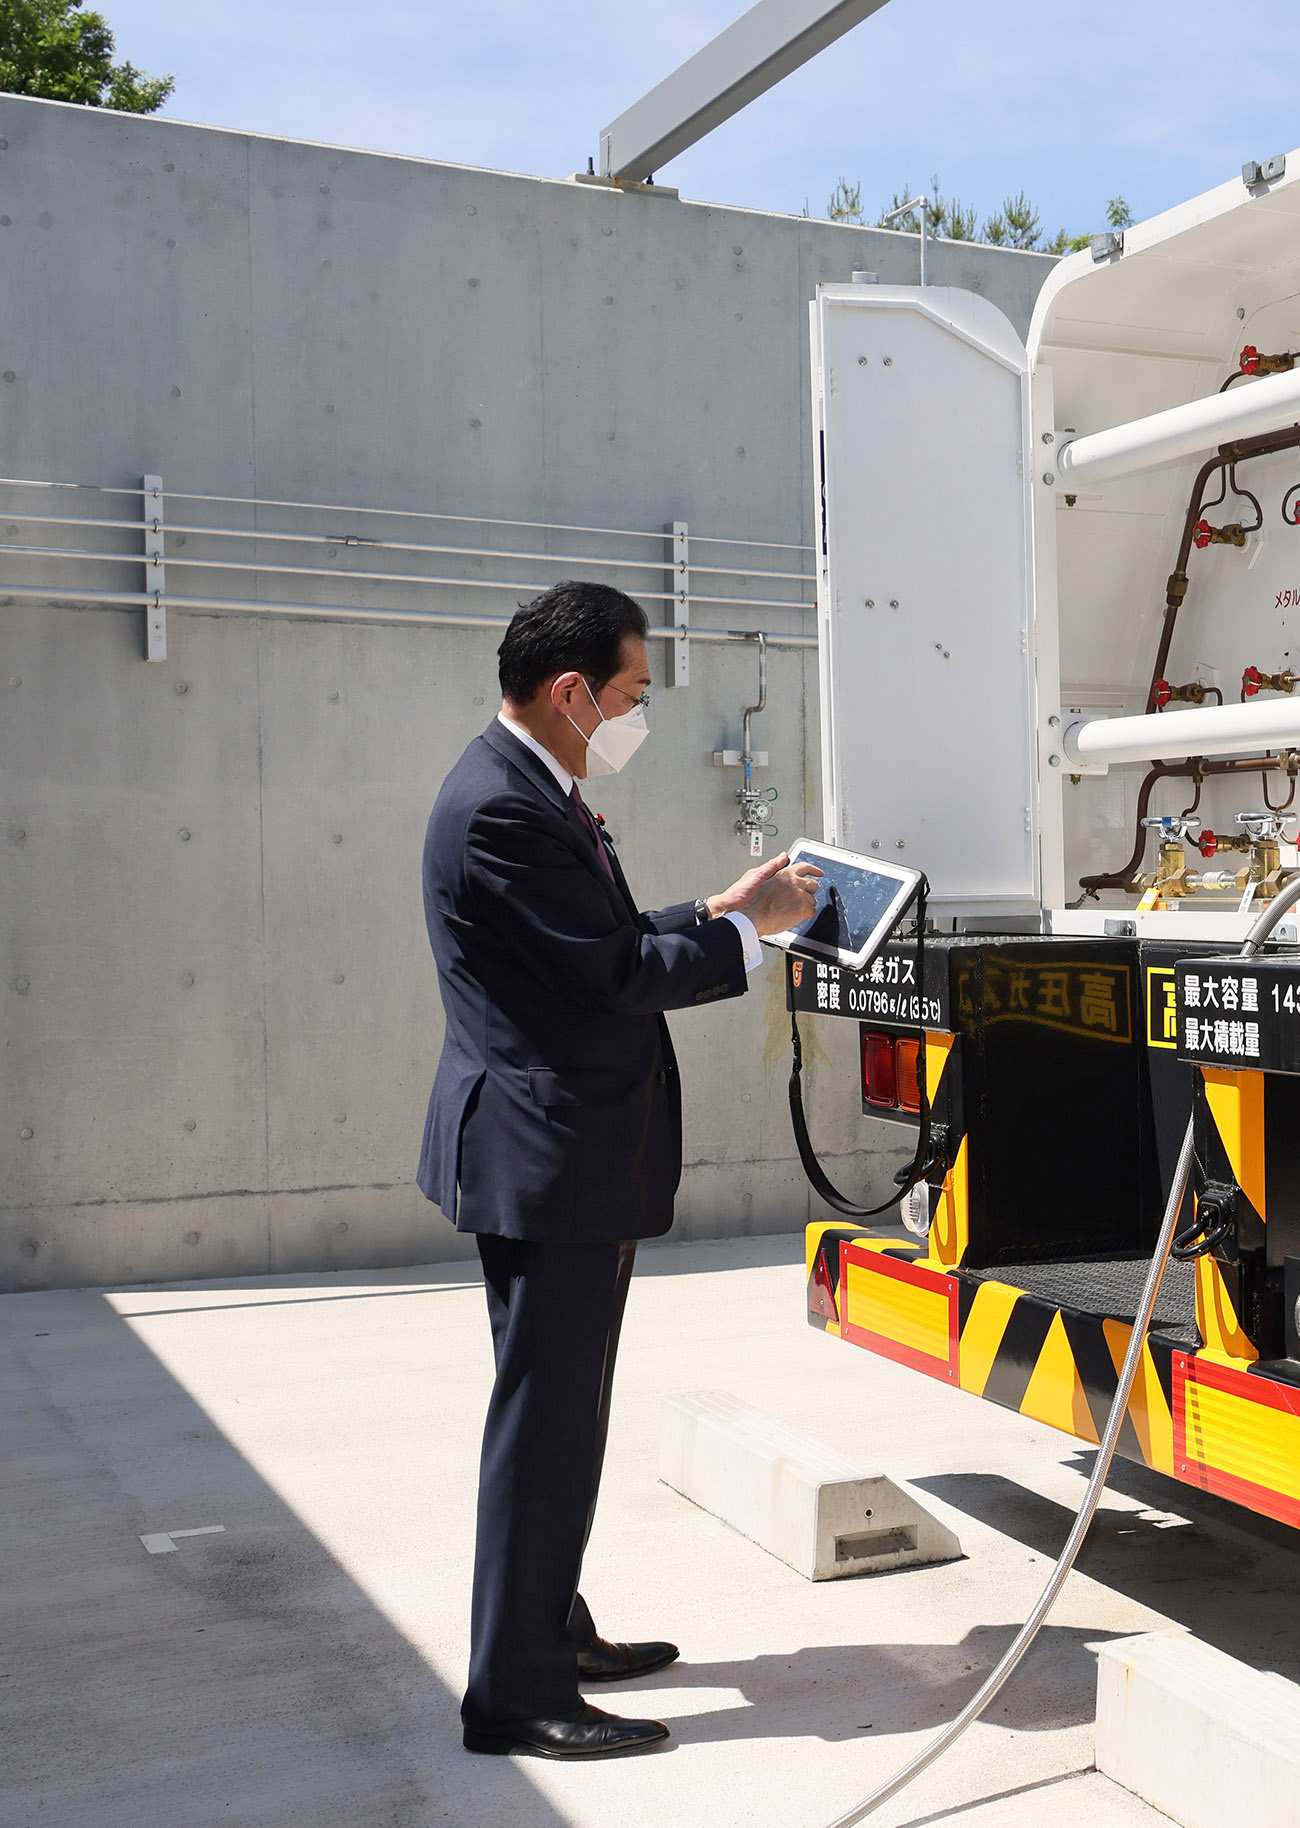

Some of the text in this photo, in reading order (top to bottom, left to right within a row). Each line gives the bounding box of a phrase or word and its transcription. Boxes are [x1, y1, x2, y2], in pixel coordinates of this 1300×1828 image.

[817, 980, 841, 1011] 密度
[1184, 974, 1259, 1013] 最大容量
[1185, 1017, 1260, 1058] 最大積載量
